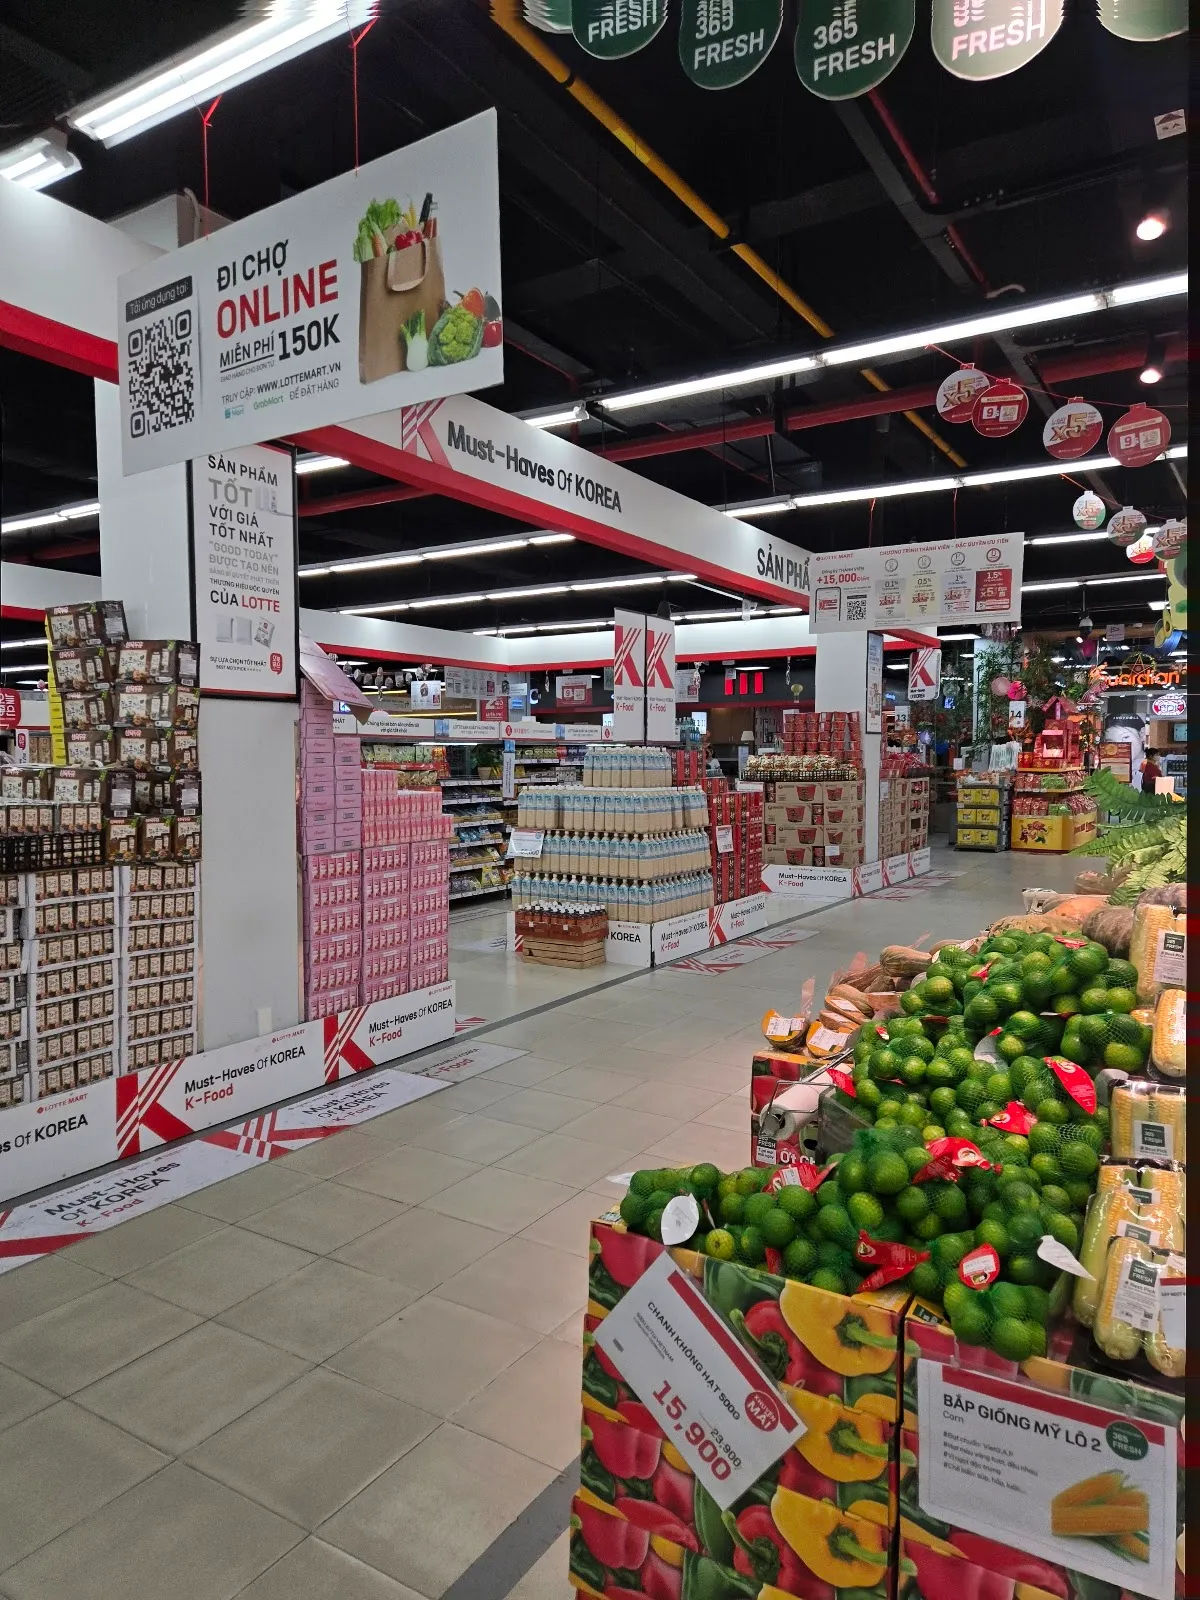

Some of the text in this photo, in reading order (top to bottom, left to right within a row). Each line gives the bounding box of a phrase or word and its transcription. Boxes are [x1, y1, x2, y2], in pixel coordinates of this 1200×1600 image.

[813, 14, 859, 50] 365
[951, 18, 1046, 62] FRESH
[693, 28, 765, 70] FRESH
[813, 33, 896, 82] FRESH
[217, 239, 290, 292] ĐI CHỢ
[217, 259, 339, 339] ONLINE
[220, 330, 275, 369] MIỄN PHÍ
[278, 313, 341, 361] 150K
[222, 391, 239, 405] TRUY
[257, 361, 341, 395] WWW.LOTTEMART.VN
[317, 377, 340, 392] HÀNG
[208, 454, 278, 486] SẢN PHẨM
[447, 420, 623, 514] Must-Haves Of KOREA
[208, 478, 252, 508] TỐT
[209, 503, 259, 528] VỚI GIÁ
[209, 522, 274, 548] TỐT NHẤT
[240, 559, 259, 573] TẠO
[756, 541, 785, 577] SẢN
[816, 573, 857, 585] +15,000
[210, 587, 280, 613] CỦA LOTTE
[616, 702, 634, 712] K-Food
[649, 703, 667, 713] K-Food
[896, 714, 907, 722] 13
[1010, 710, 1022, 718] 14
[779, 873, 847, 883] Must-Haves KOREA
[779, 880, 804, 888] K-Food
[610, 931, 641, 943] KOREA
[660, 940, 680, 952] K-Food
[369, 998, 453, 1034] Must-Haves Of KOREA
[369, 1027, 403, 1048] K-Food
[184, 1045, 306, 1095] Must-Haves Of KOREA
[44, 1093, 88, 1112] LOTTE MART
[185, 1082, 234, 1111] K-Food
[302, 1081, 391, 1115] Must-Haves
[335, 1091, 389, 1113] KOREA
[332, 1104, 377, 1123] K-Food
[14, 1130, 32, 1149] Of
[34, 1113, 89, 1143] KOREA
[758, 1138, 776, 1149] FRESH
[780, 1148, 797, 1164] Ớt
[44, 1162, 181, 1216] Must-Haves
[60, 1178, 171, 1221] Of KOREA
[76, 1199, 145, 1228] K-Food
[1132, 1272, 1153, 1283] FRESH
[647, 1301, 676, 1338] CHANH
[673, 1334, 704, 1373] KHÔNG
[702, 1370, 721, 1395] HẠT
[719, 1391, 742, 1421] 500G
[652, 1379, 732, 1481] 15,900
[943, 1410, 965, 1425] Corn
[943, 1393, 1102, 1453] BẮP GIỐNG MỸ LÔ 2
[1112, 1431, 1129, 1444] 365
[1112, 1440, 1142, 1457] FRESH
